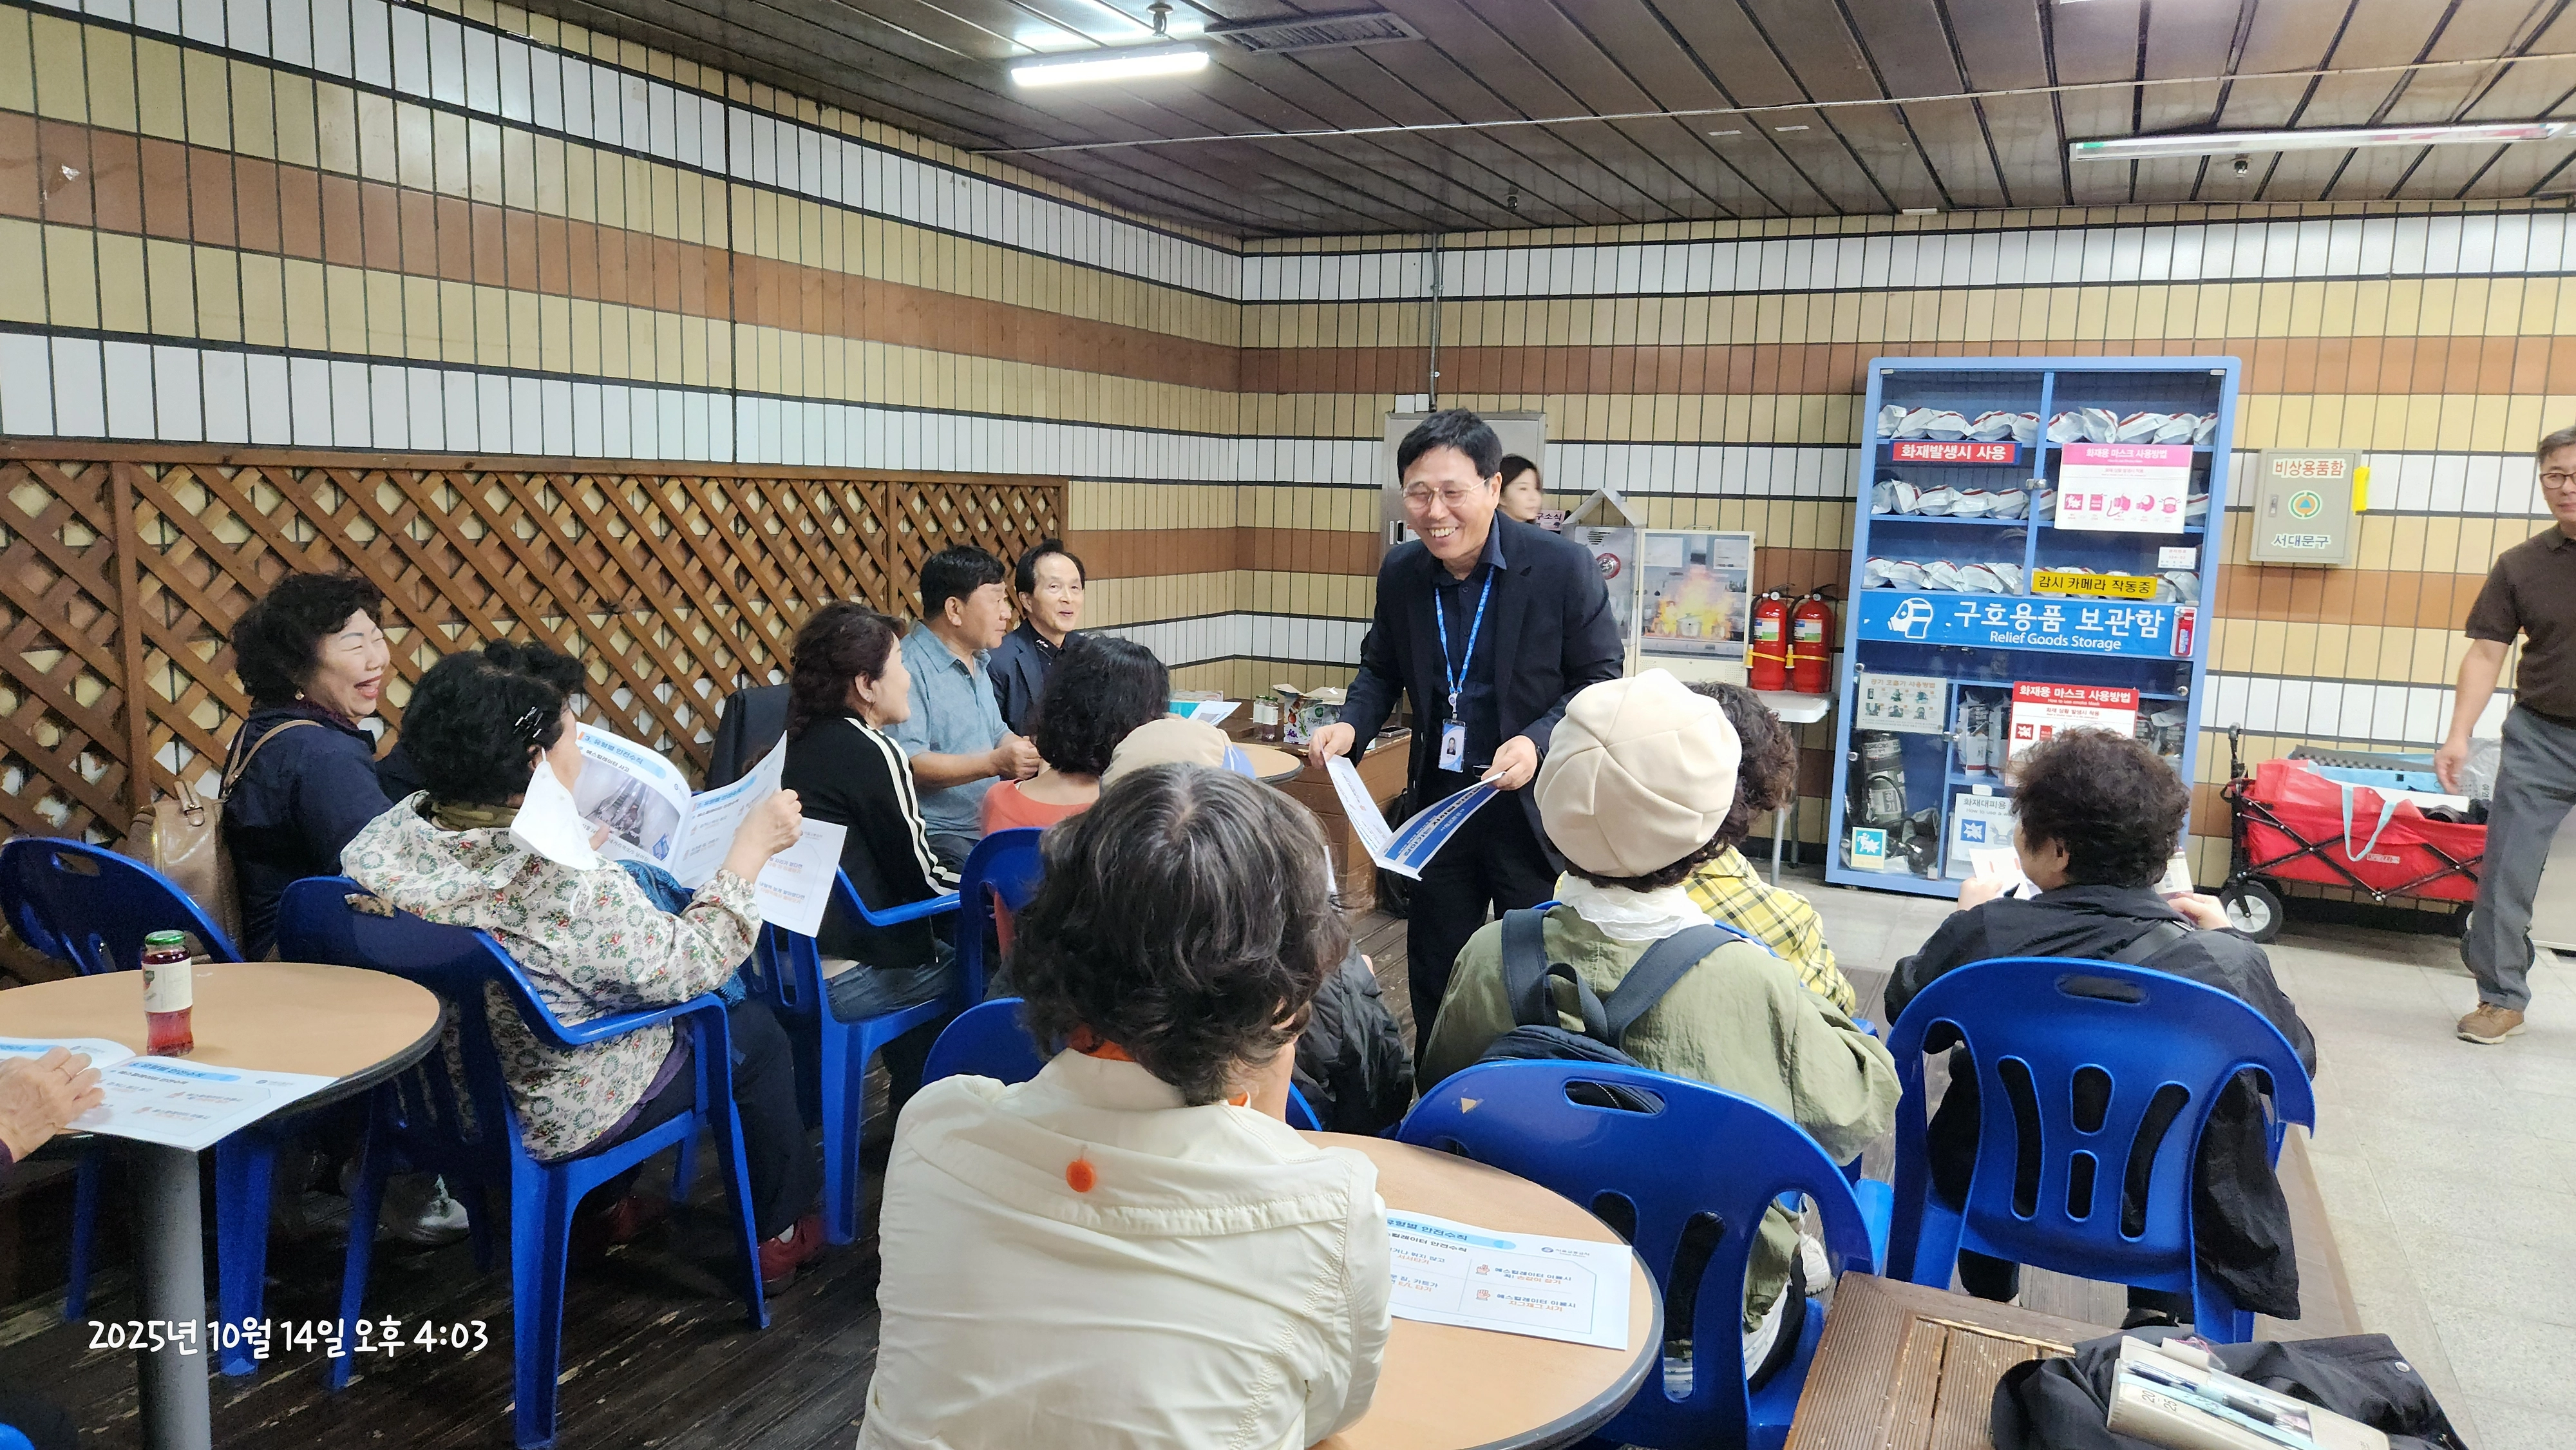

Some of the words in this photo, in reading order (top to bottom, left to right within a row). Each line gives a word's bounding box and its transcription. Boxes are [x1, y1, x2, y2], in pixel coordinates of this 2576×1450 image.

[1901, 444, 1971, 459] 화재발생시
[1976, 445, 2006, 461] 사용
[2086, 448, 2109, 458] 화재용
[2111, 448, 2134, 458] 마스크
[2136, 449, 2168, 459] 사용방법
[2275, 460, 2344, 477] 비상용품함
[2273, 535, 2329, 548] 서대문구
[2039, 576, 2063, 589] 감시
[2067, 577, 2107, 591] 카메라
[2112, 580, 2150, 594] 작동중
[1954, 601, 2066, 633] 구호용품
[2075, 607, 2165, 638] 보관함
[1990, 631, 2026, 644] Relief
[2027, 633, 2068, 647] Goods
[2070, 635, 2121, 651] Storage
[2019, 685, 2050, 698] 화재용
[2054, 687, 2085, 700] 마스크
[2088, 690, 2131, 703] 사용방법
[1885, 791, 1896, 811] 공기
[1963, 798, 2007, 810] 화재대피용
[1421, 1226, 1468, 1241] 안전수칙
[1430, 1241, 1467, 1252] 안전수칙
[1397, 1254, 1430, 1264] 서서타기
[1495, 1267, 1544, 1278] 에스컬레이터
[1414, 1278, 1438, 1288] 카트가
[1497, 1293, 1548, 1304] 에스컬레이터
[1551, 1300, 1576, 1308] 이용시
[1508, 1300, 1543, 1310] 지그재그
